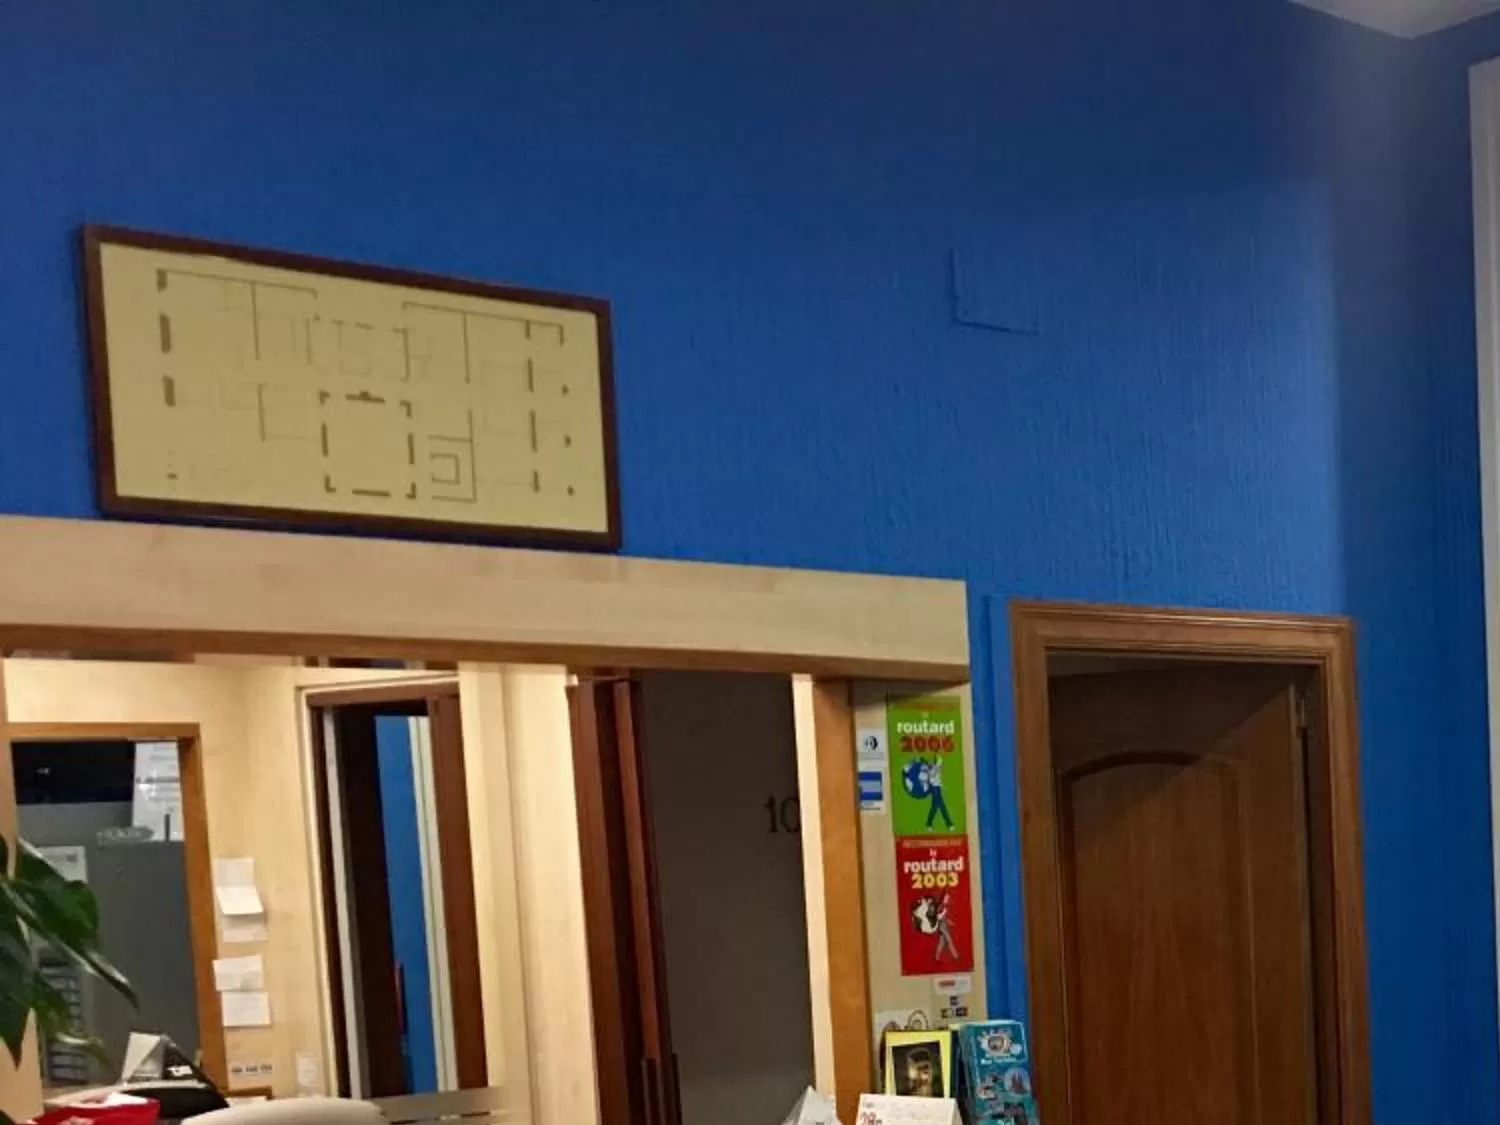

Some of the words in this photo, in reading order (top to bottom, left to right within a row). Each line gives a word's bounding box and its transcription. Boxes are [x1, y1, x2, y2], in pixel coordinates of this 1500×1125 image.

[897, 720, 955, 734] routard
[903, 856, 964, 874] routard
[911, 872, 959, 889] 2003
